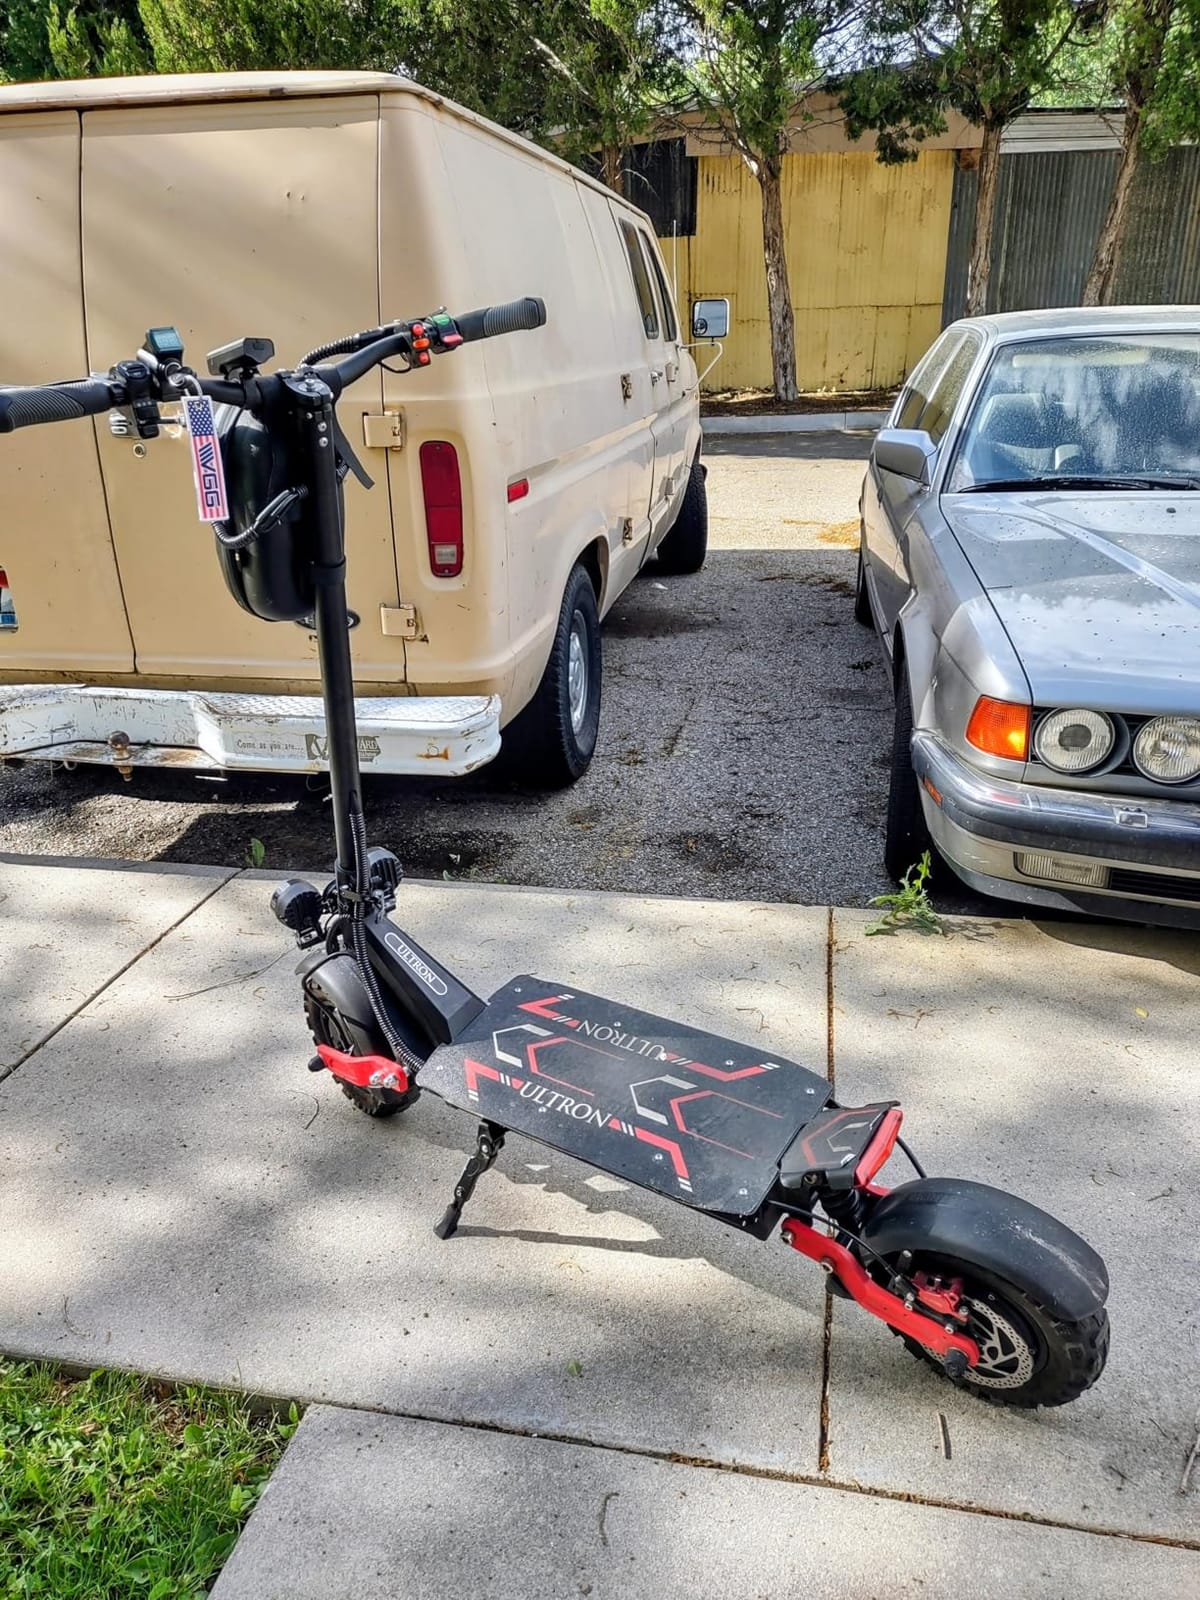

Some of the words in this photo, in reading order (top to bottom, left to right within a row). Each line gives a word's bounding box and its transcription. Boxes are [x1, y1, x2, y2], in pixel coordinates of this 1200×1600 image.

[397, 944, 436, 983] ULTRON
[576, 1019, 666, 1061] ULTRON
[519, 1081, 611, 1129] ULTRON
